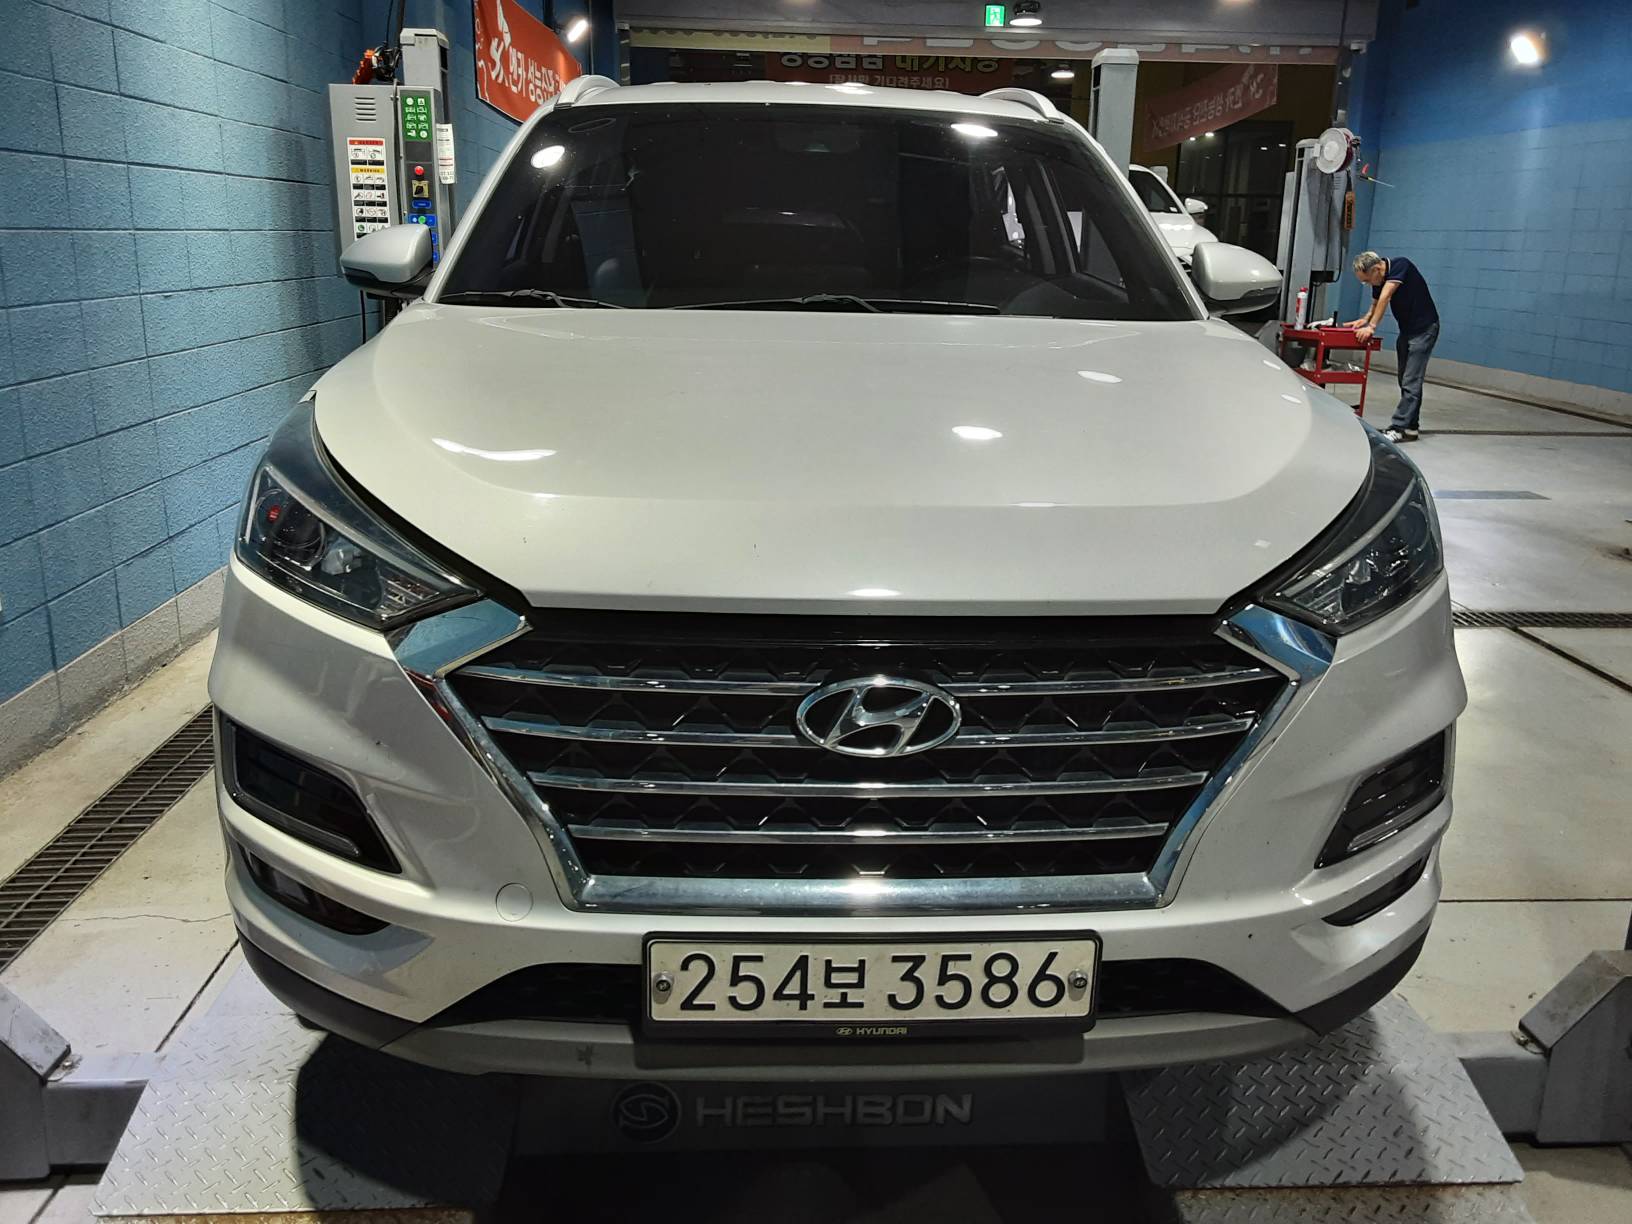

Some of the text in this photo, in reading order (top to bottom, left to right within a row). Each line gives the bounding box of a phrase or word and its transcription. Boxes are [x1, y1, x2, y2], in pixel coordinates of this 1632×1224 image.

[679, 951, 1067, 1011] 254보 3586
[855, 1026, 908, 1036] HYUNDAI
[696, 1093, 974, 1127] HESHBON
